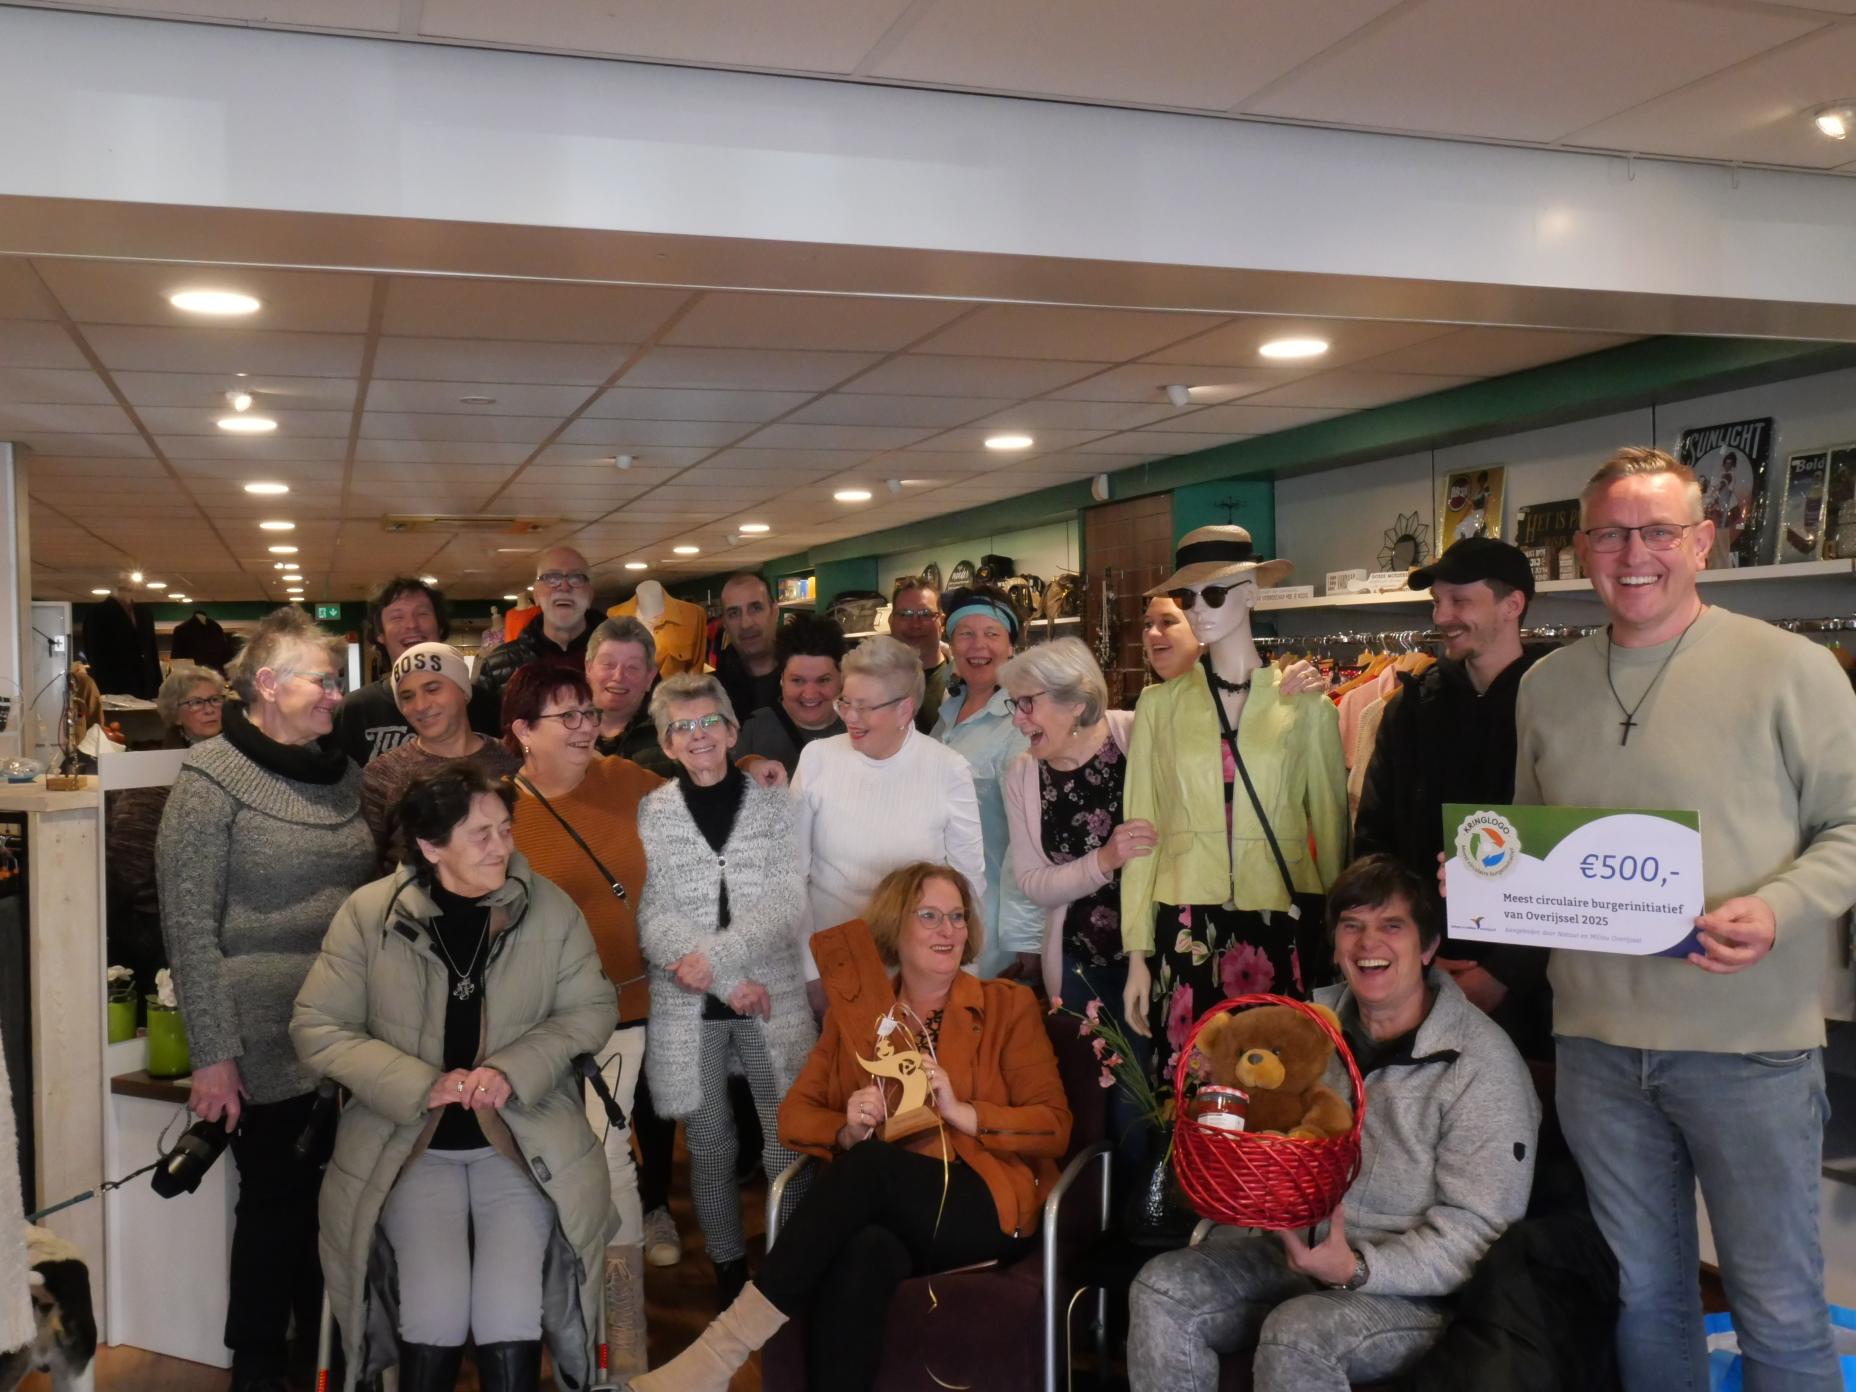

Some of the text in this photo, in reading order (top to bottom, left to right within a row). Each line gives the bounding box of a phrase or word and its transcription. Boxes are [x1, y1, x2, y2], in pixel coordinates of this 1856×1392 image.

[1687, 422, 1766, 466] SUNLIGHT
[1792, 457, 1826, 473] Bold
[393, 653, 442, 681] BOSS
[1463, 816, 1510, 835] KRINGLOGO
[1579, 853, 1680, 887] €500,-
[1503, 893, 1684, 914] Meest circulaire burgerinitiatief
[1504, 911, 1609, 926] van Overijssel 2025
